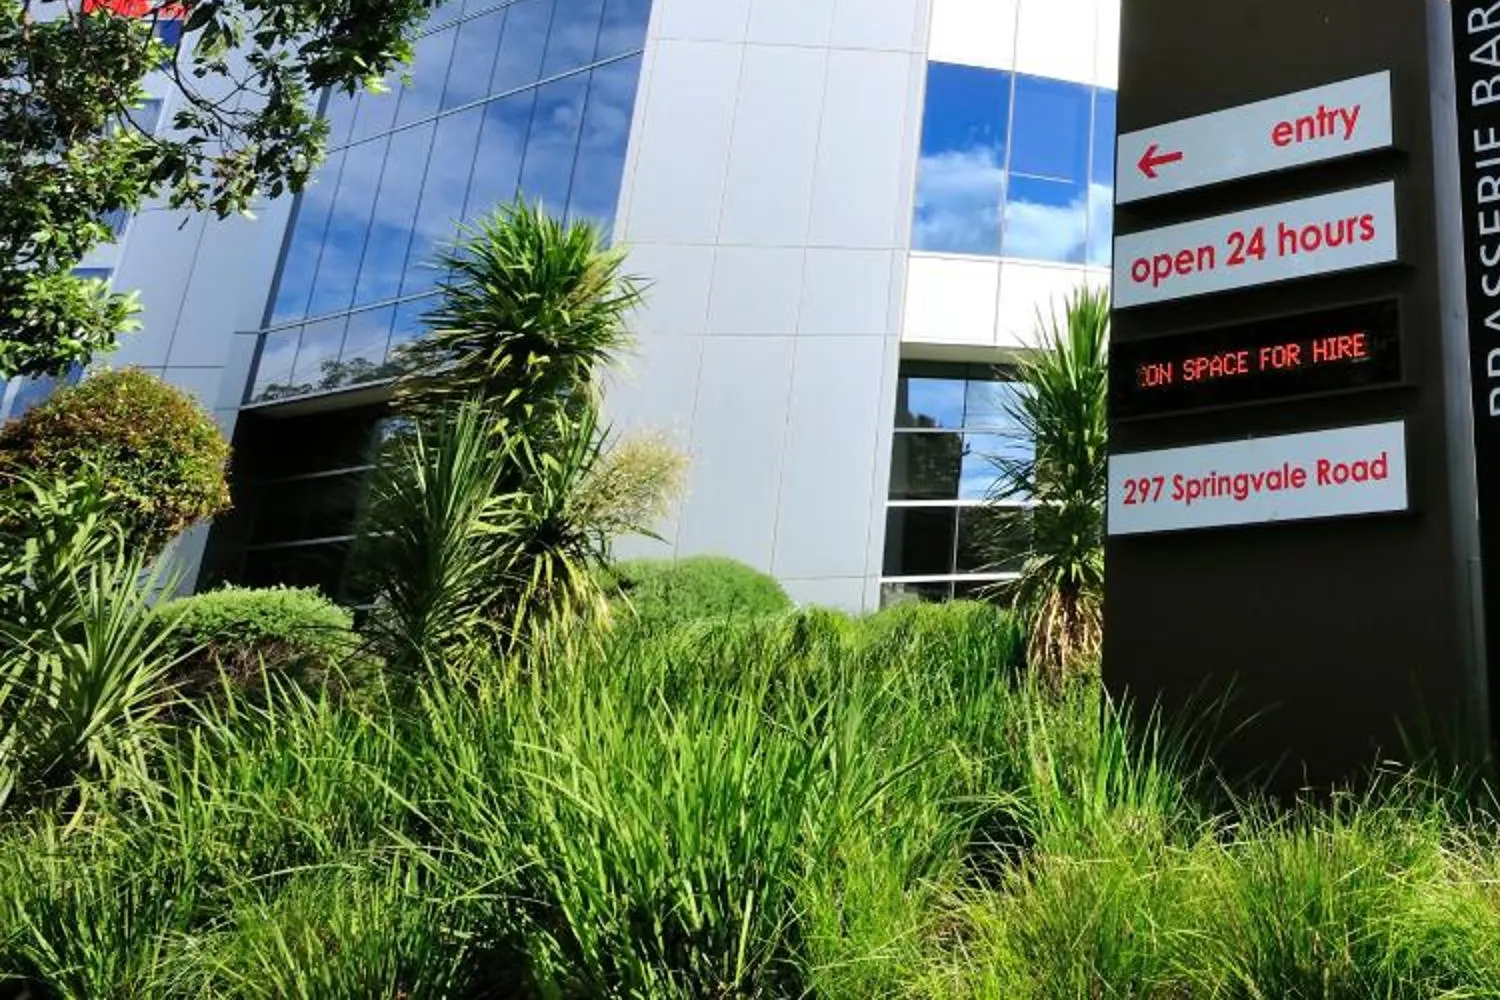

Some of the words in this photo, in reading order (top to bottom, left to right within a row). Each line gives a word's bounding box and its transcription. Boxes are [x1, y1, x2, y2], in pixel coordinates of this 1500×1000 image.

[1271, 104, 1361, 147] entry
[1131, 244, 1216, 288] open
[1226, 226, 1266, 266] 24
[1278, 212, 1375, 257] hours
[1183, 351, 1249, 381] SPACE
[1259, 343, 1301, 371] FOR
[1313, 333, 1366, 363] HIRE
[1122, 477, 1164, 505] 297
[1171, 462, 1307, 506] Springvale
[1316, 452, 1389, 486] Road
